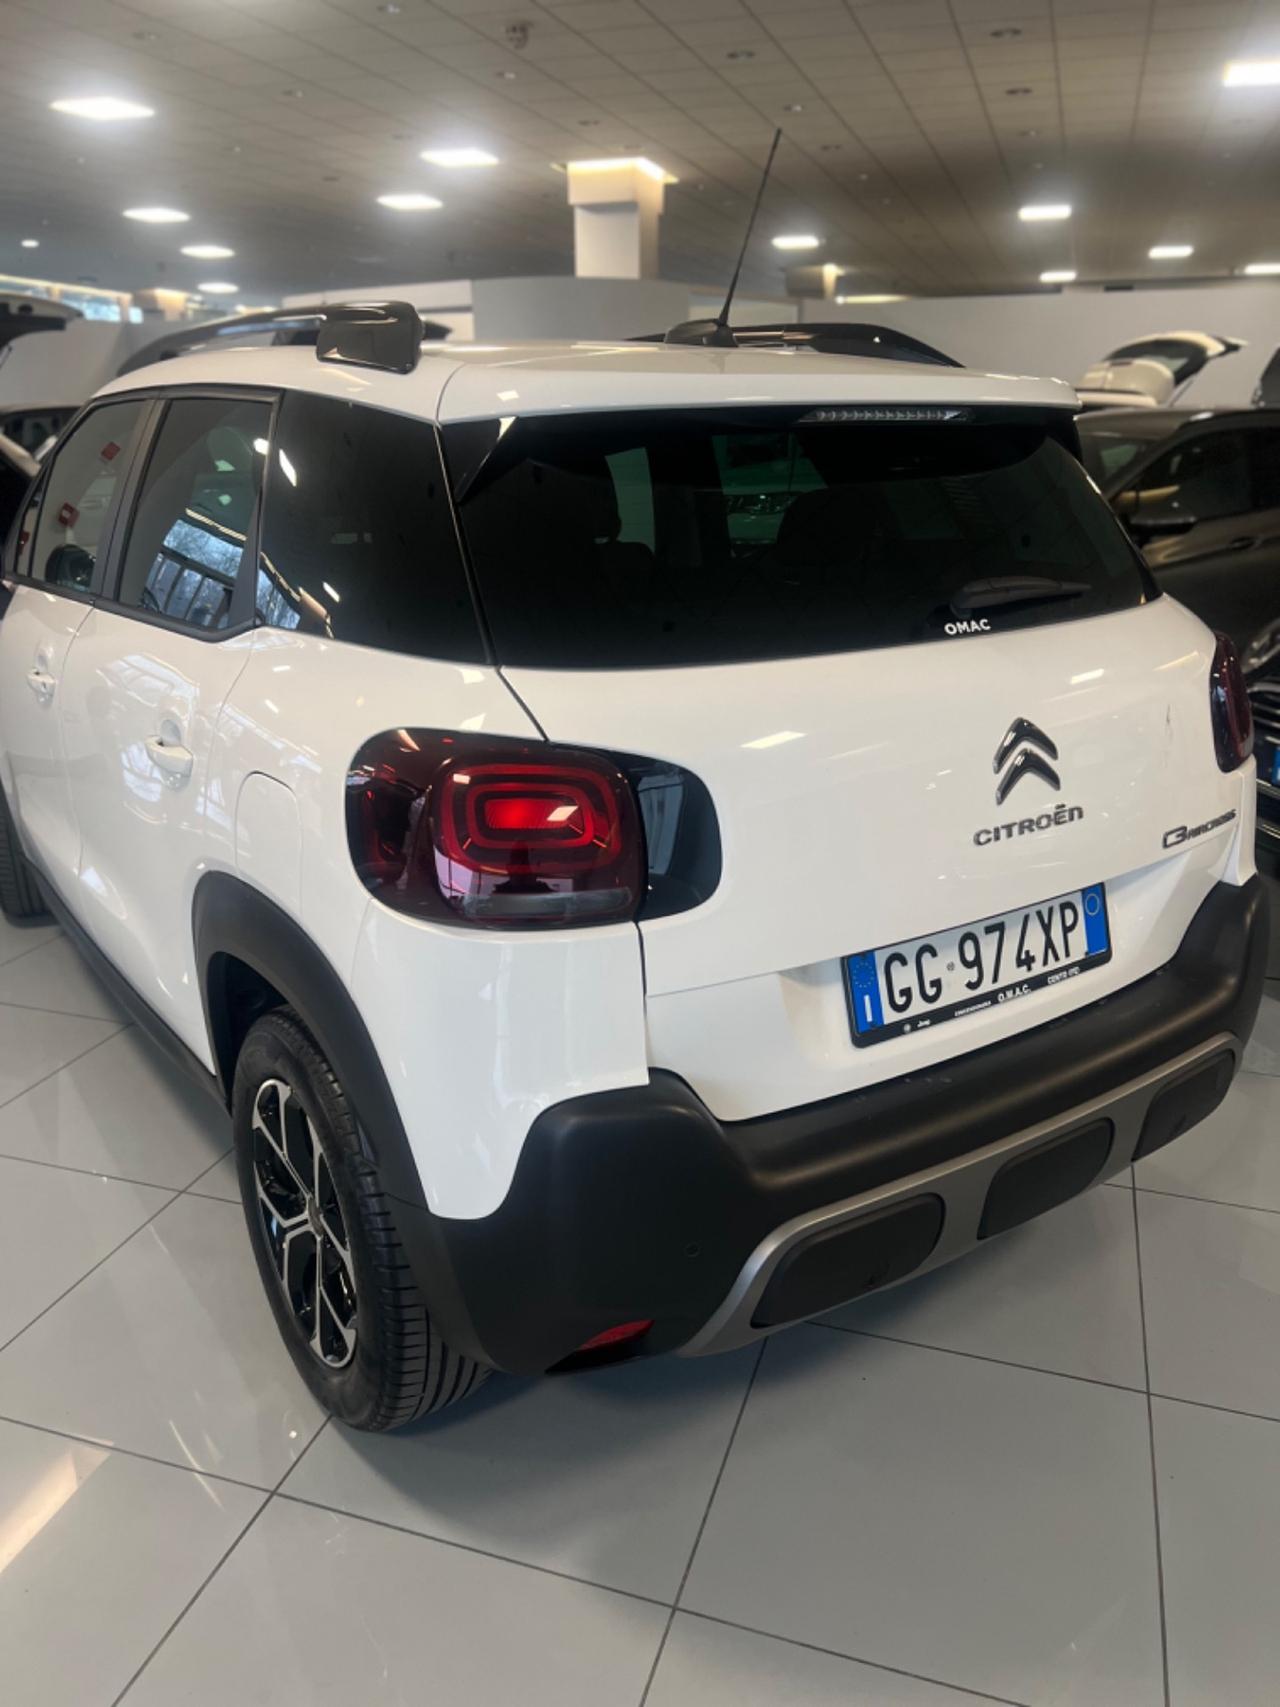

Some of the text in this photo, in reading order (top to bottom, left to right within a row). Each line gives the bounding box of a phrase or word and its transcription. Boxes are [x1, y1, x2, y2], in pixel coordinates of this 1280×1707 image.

[944, 618, 991, 635] OMAC
[884, 900, 1079, 1013] GG 974XP
